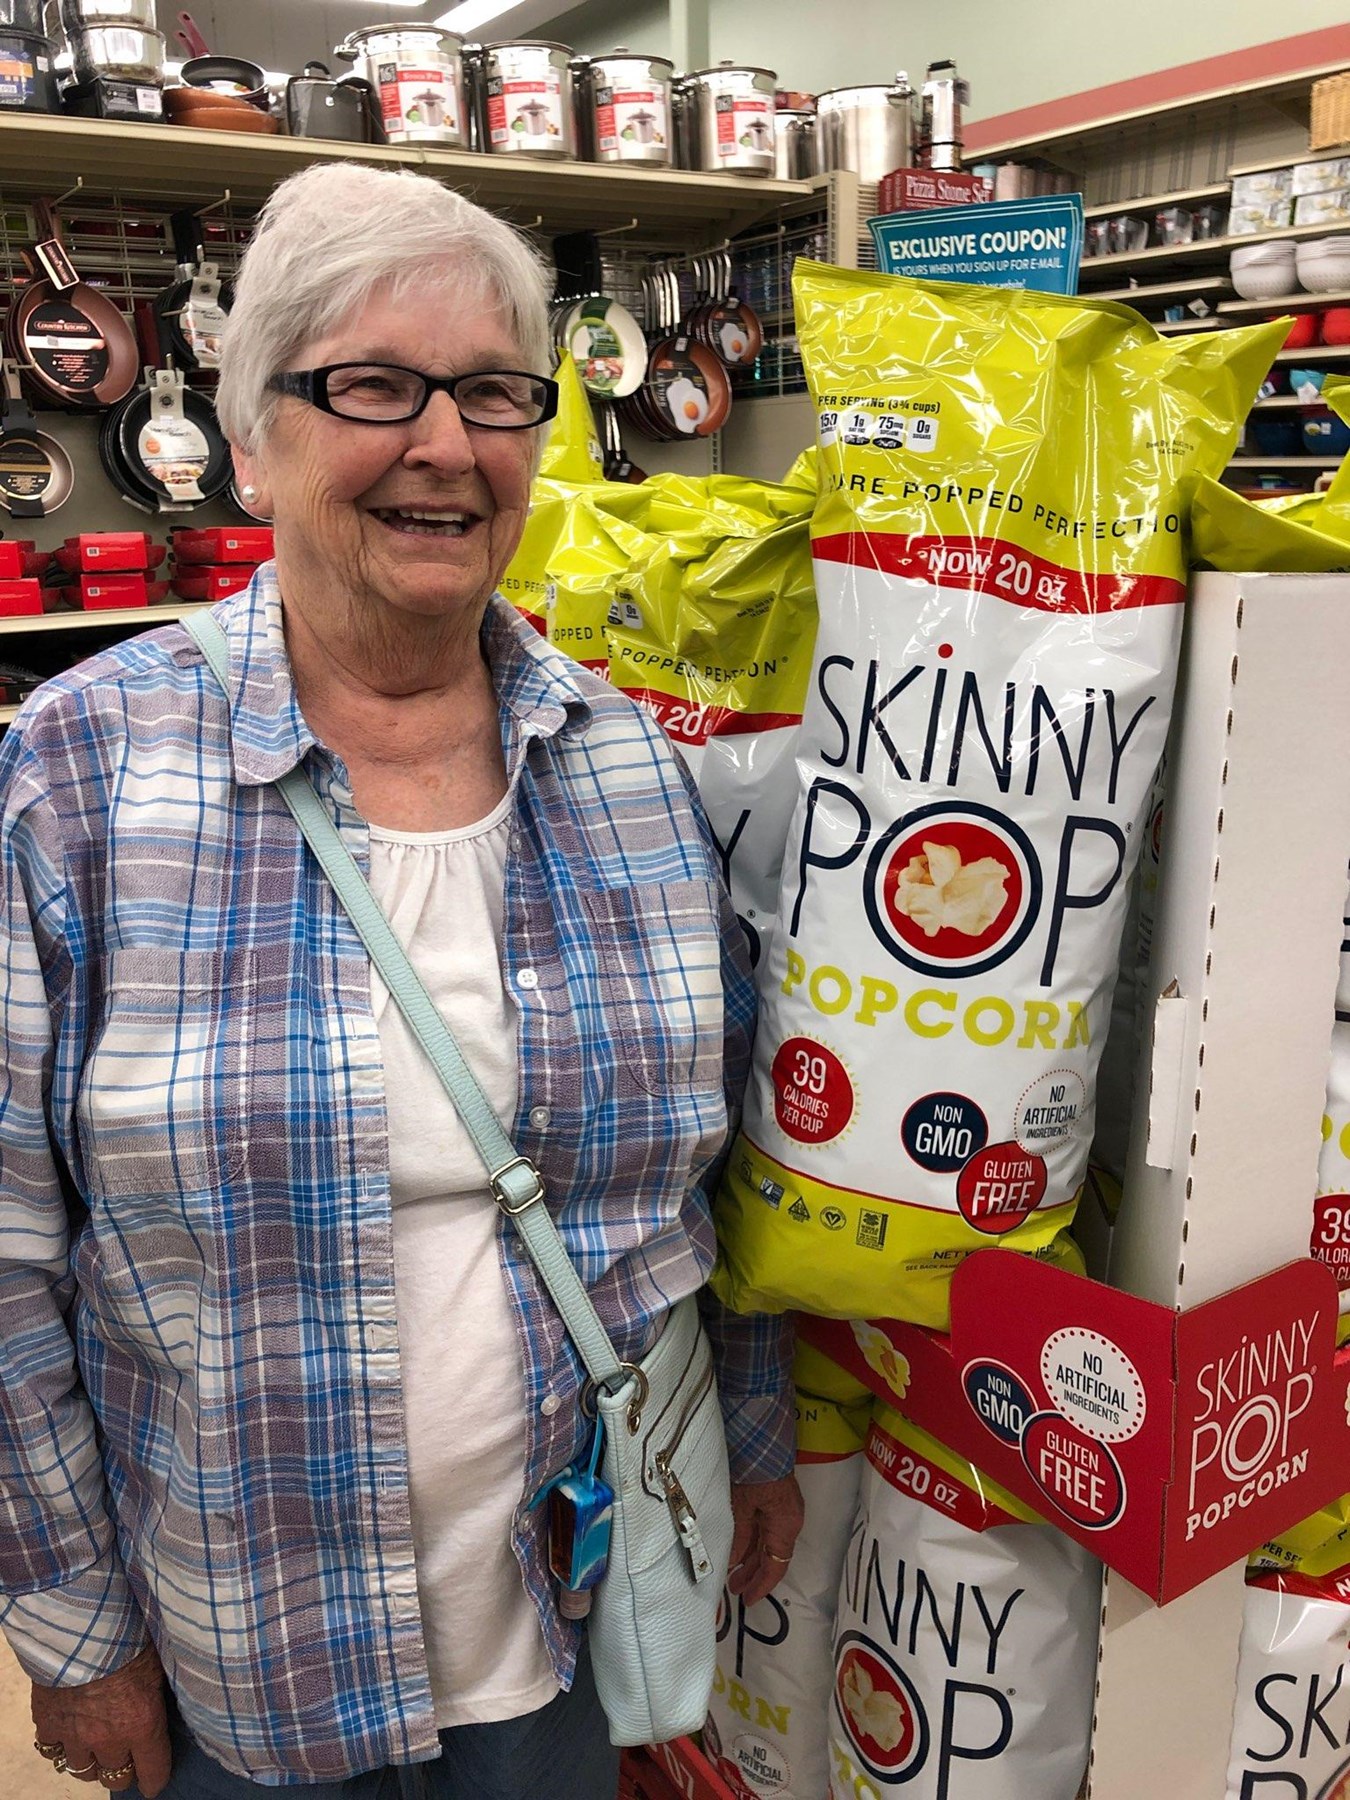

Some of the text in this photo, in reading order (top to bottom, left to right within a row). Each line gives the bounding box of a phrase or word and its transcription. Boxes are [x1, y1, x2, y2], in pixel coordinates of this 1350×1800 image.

[889, 226, 1067, 260] EXCLUSIVE COUPON!
[901, 264, 928, 276] YOURS
[929, 263, 954, 275] WHEN
[955, 261, 973, 273] YOU
[974, 260, 996, 272] SIGN
[996, 259, 1009, 271] UP
[1010, 258, 1030, 271] FOR
[818, 394, 838, 407] PER
[912, 401, 941, 414] cups)
[820, 412, 838, 429] 150
[852, 414, 865, 428] 1g
[916, 419, 931, 434] 0g
[829, 474, 886, 496] URE
[903, 480, 1024, 514] POPPED
[928, 548, 992, 576] NOW
[995, 553, 1033, 596] 20
[664, 705, 704, 737] 20
[818, 642, 1158, 804] SKINNY
[790, 776, 1128, 987] POP
[780, 947, 1091, 1051] POPCORN
[792, 1050, 827, 1094] 39
[782, 1084, 829, 1120] CALORIES
[1049, 1085, 1066, 1103] NO
[781, 1107, 825, 1135] PER CUP
[933, 1104, 963, 1125] NON
[1022, 1103, 1077, 1126] ARTIFICIAL
[1025, 1124, 1070, 1140] INGREDIENTS
[914, 1122, 974, 1159] GMO
[983, 1159, 1033, 1180] GLUTEN
[970, 1180, 1036, 1218] FREE
[932, 1250, 961, 1260] NET
[1082, 1350, 1103, 1376] NO
[1193, 1310, 1320, 1422] SKINNY
[987, 1372, 1012, 1400] NON
[1055, 1368, 1129, 1414] ARTIFICIAL
[976, 1388, 1023, 1435] GMO
[1063, 1389, 1121, 1426] INGREDIENTS
[1046, 1429, 1099, 1474] GLUTEN
[1188, 1372, 1316, 1511] POP
[869, 1433, 961, 1510] NOW 20 OZ
[1038, 1447, 1107, 1518] FREE
[1184, 1448, 1310, 1542] POPCORN
[737, 1749, 784, 1782] ARTIFICIAL
[753, 1745, 768, 1762] NO
